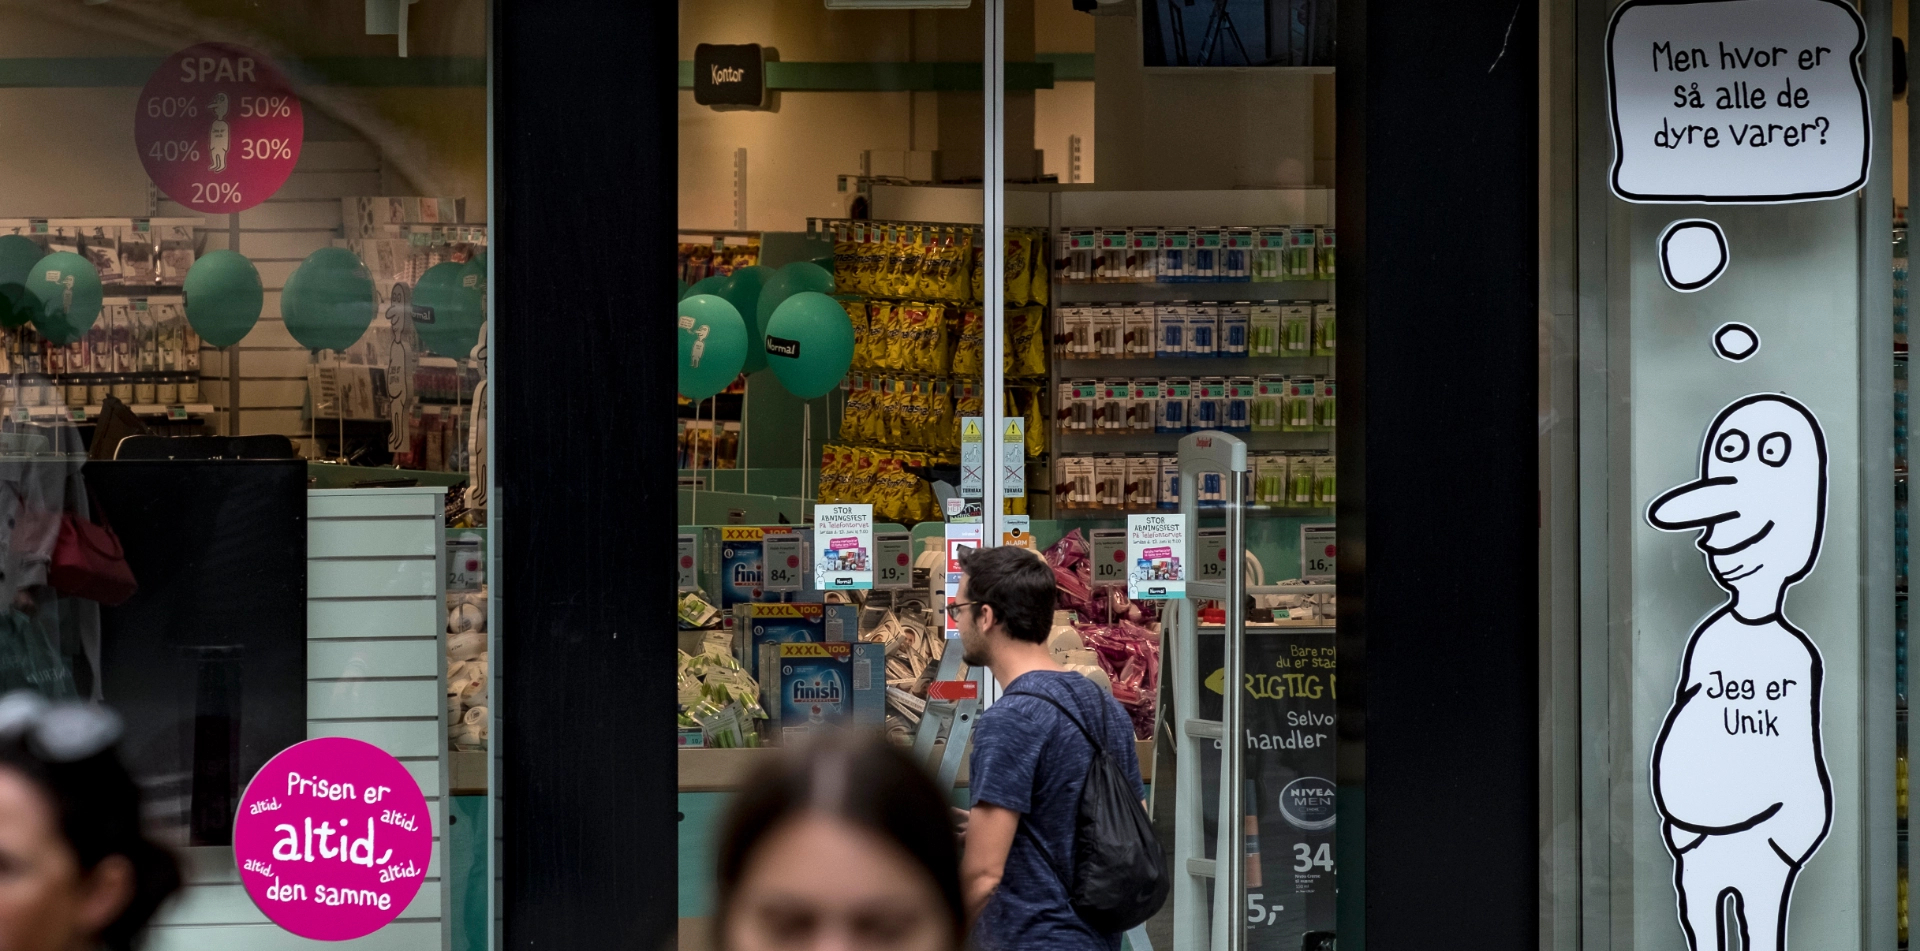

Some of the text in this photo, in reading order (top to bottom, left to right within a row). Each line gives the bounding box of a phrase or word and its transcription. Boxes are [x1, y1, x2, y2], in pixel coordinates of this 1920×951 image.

[1652, 41, 1831, 72] Men hvor er
[180, 57, 256, 83] SPAR
[711, 63, 744, 85] Kontor
[1674, 77, 1810, 110] så alle de
[147, 96, 198, 118] 60%
[240, 96, 291, 118] 50%
[1654, 116, 1830, 149] dyre varer?
[149, 140, 200, 162] 40%
[241, 138, 291, 160] 30%
[191, 182, 242, 204] 20%
[411, 310, 431, 320] ormal
[767, 338, 796, 355] Normal
[833, 506, 853, 514] STOR
[1146, 516, 1165, 524] STOR
[726, 530, 763, 539] XXXL
[734, 563, 762, 582] fini
[881, 567, 905, 581] 19,-
[1098, 564, 1122, 577] 10,-
[1203, 563, 1226, 576] 19,-
[1309, 559, 1333, 572] 16,-
[449, 572, 474, 586] 24,-
[771, 569, 795, 583] 84,-
[755, 606, 793, 616] XXXL
[785, 646, 822, 655] XXXL
[1290, 645, 1318, 657] Bare
[1276, 655, 1291, 668] du
[1294, 658, 1309, 668] er
[793, 679, 840, 699] finish
[1707, 670, 1797, 701] Jeg er
[1287, 710, 1336, 727] Selvo
[1724, 707, 1780, 737] Unik
[1246, 729, 1328, 750] handler
[287, 771, 391, 804] Prisen er
[1290, 788, 1335, 797] NIVEA
[1294, 797, 1331, 806] MEN
[266, 876, 392, 911] den samme
